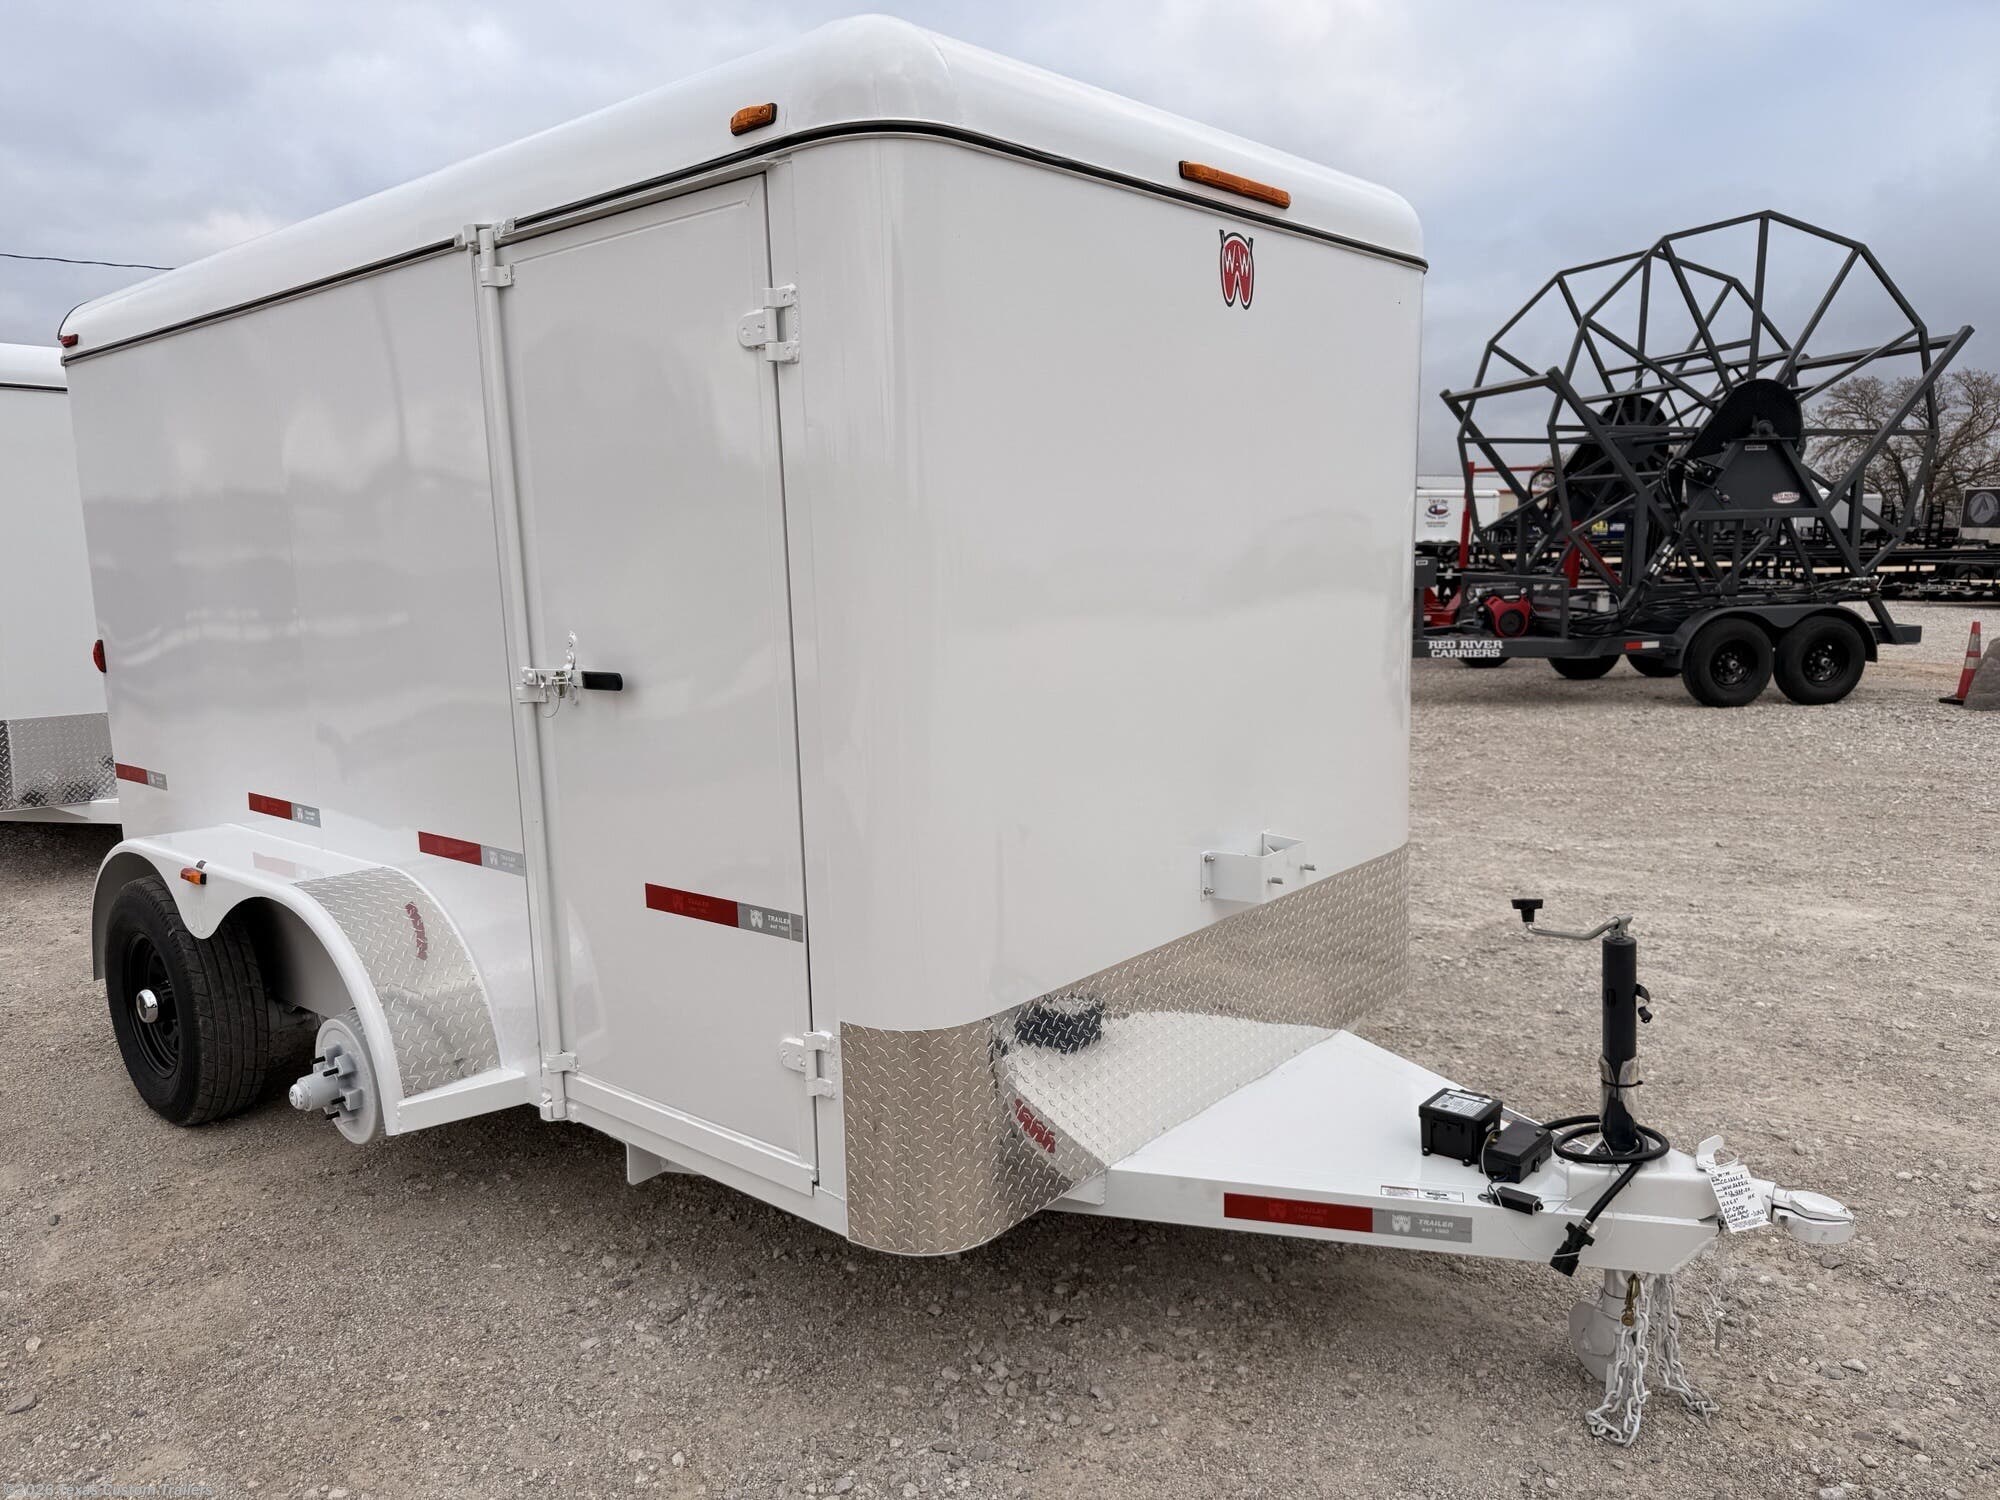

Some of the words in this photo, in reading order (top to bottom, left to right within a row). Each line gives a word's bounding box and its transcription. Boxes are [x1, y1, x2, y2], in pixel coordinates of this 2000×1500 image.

[1428, 640, 1456, 649] RED
[1460, 640, 1504, 649] RIVER
[1431, 649, 1500, 658] CARRIERS
